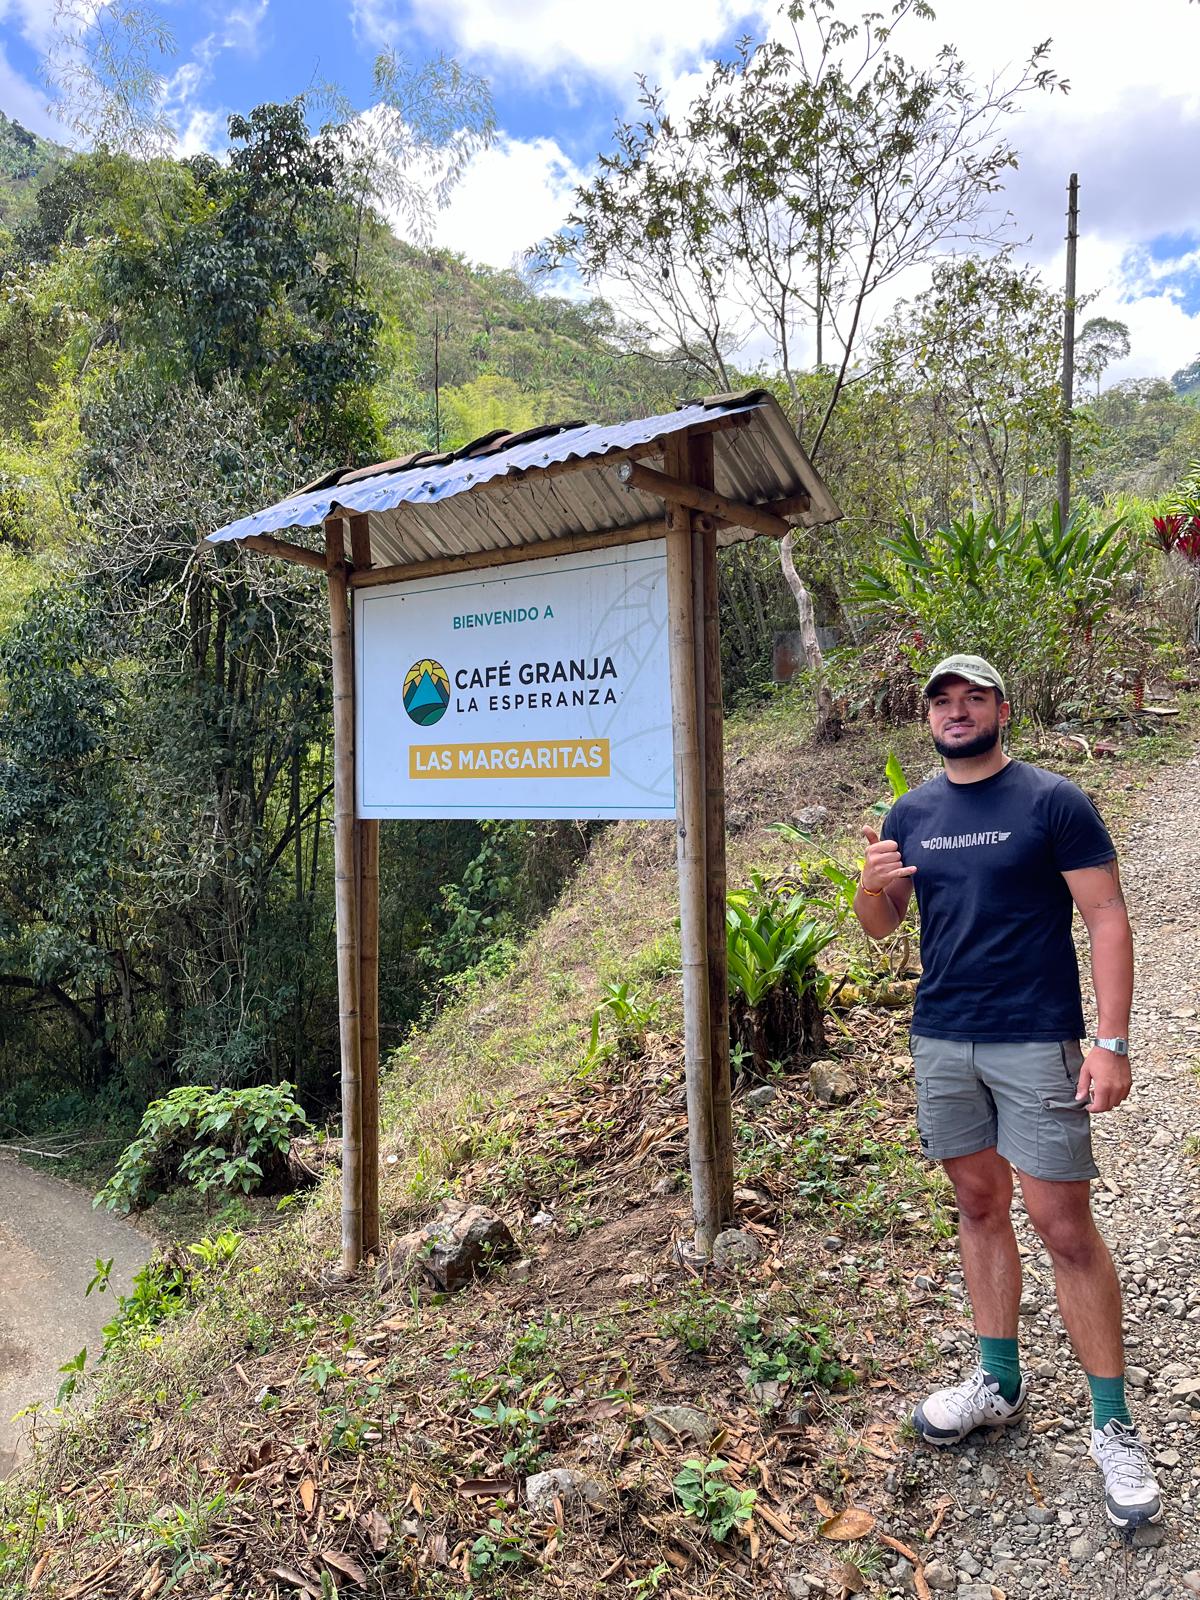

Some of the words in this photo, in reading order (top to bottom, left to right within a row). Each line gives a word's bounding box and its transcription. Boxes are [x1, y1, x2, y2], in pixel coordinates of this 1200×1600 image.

[453, 606, 539, 630] BIENVENIDO
[543, 604, 554, 619] A
[455, 660, 511, 690] CAFÉ
[518, 656, 618, 685] GRANJA
[456, 697, 479, 713] LA
[489, 688, 617, 711] ESPERANZA
[415, 751, 453, 771] LAS
[458, 746, 603, 770] MARGARITAS
[929, 831, 999, 850] COMANDANTE
